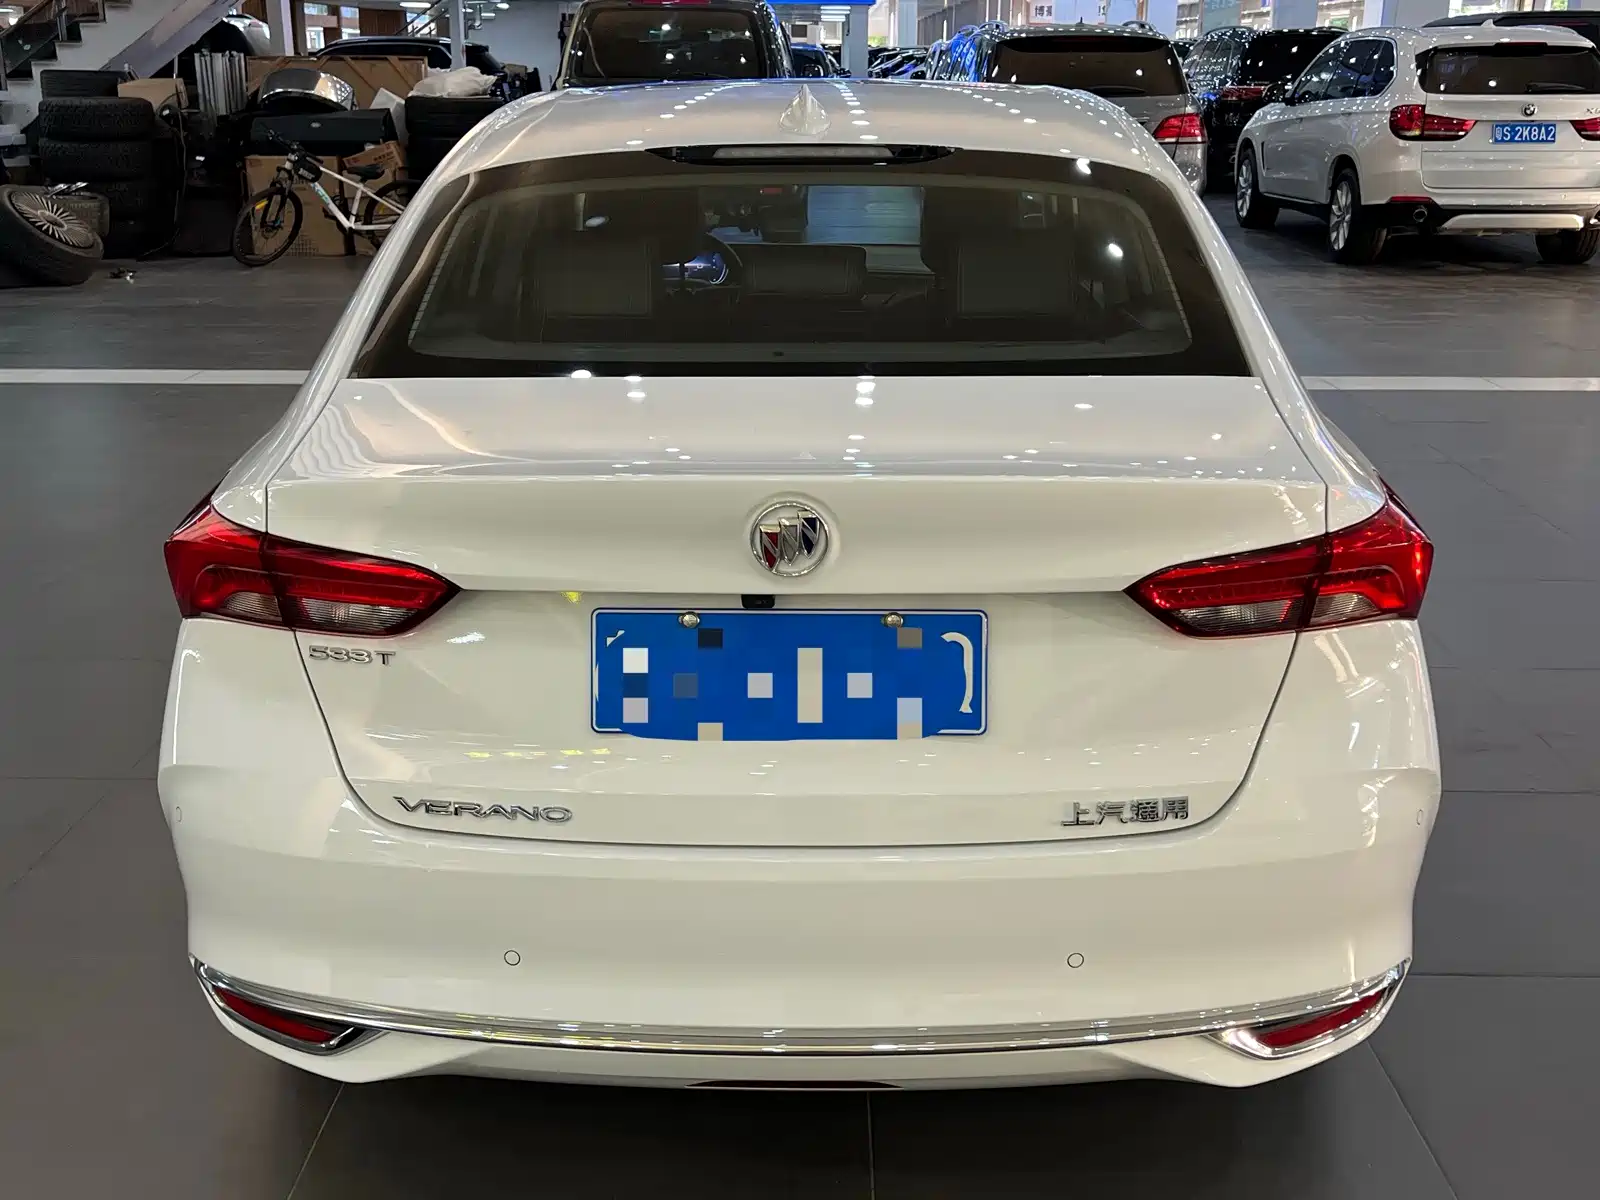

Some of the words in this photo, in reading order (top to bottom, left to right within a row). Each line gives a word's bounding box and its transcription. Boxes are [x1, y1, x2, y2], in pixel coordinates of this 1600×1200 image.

[393, 796, 573, 823] VERANO
[1061, 796, 1189, 826] 上汽通用
